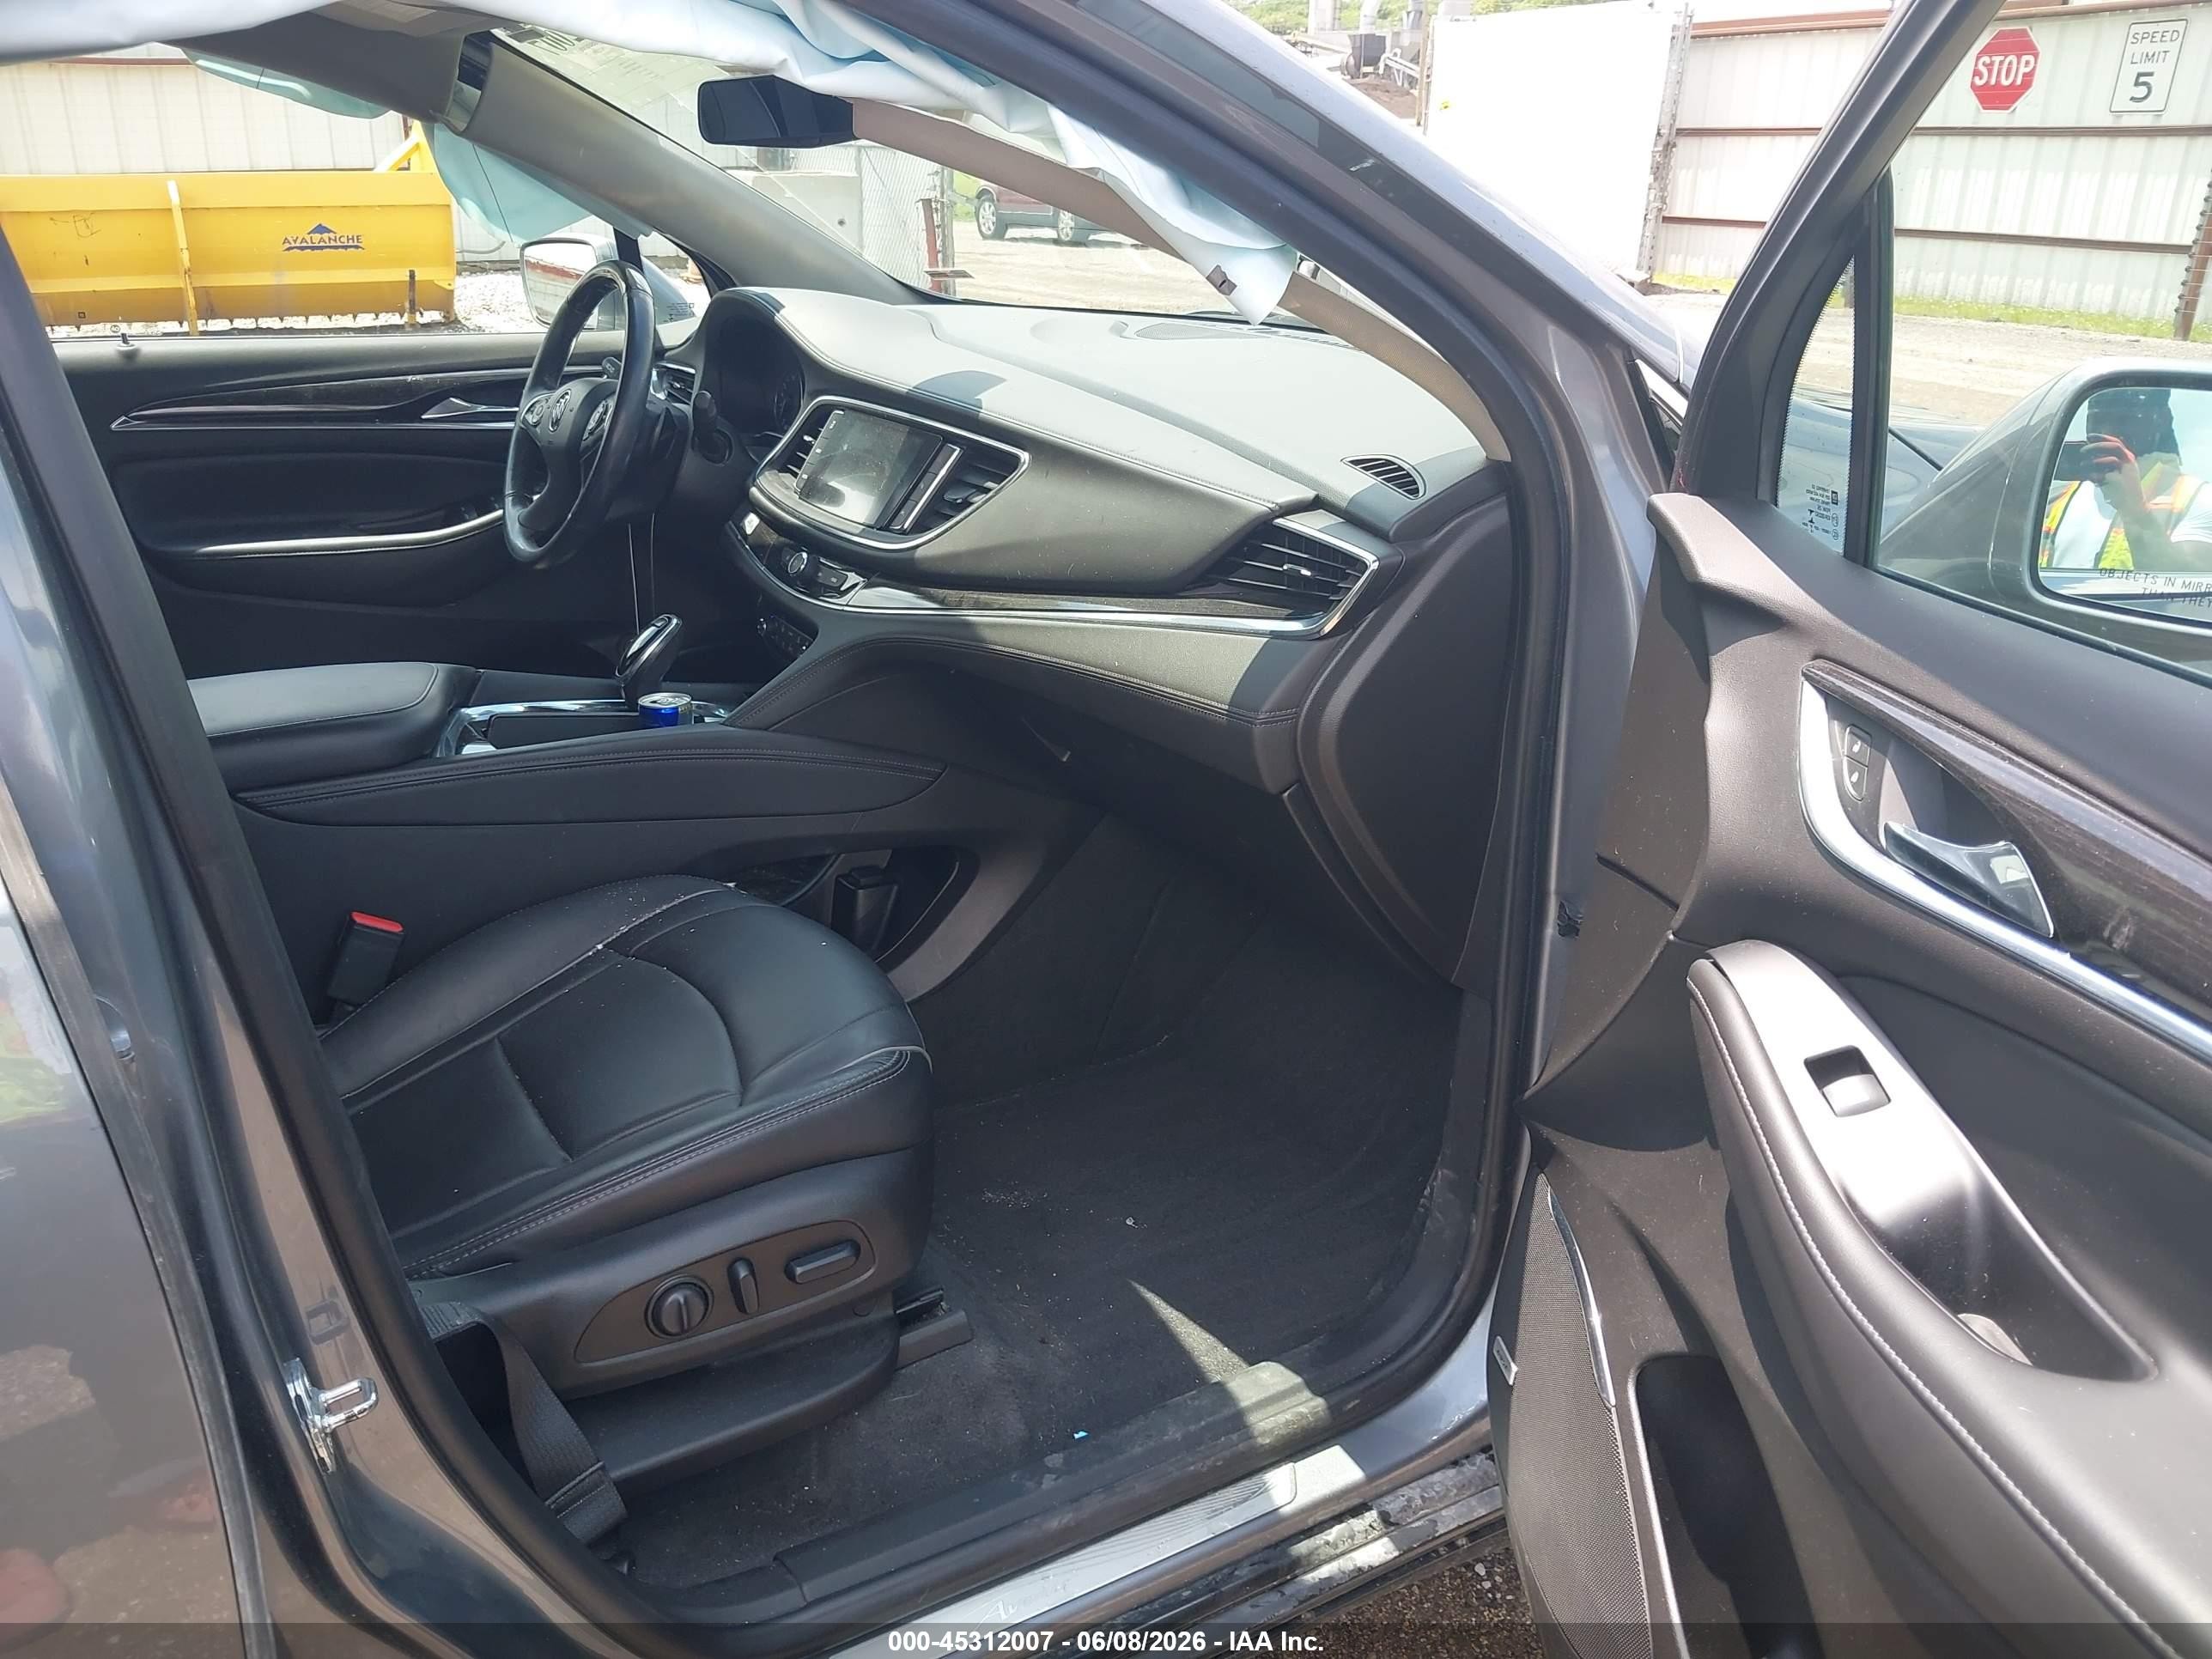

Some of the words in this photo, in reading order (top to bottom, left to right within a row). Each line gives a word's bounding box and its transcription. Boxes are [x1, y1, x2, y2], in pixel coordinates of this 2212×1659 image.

[2130, 30, 2180, 45] SPEED
[2130, 50, 2171, 64] LIMIT
[1974, 54, 2035, 86] STOP
[2129, 71, 2154, 103] 5
[282, 234, 363, 246] AVALANCHE
[2100, 567, 2160, 586] OBJECTS
[2163, 576, 2177, 587] IN
